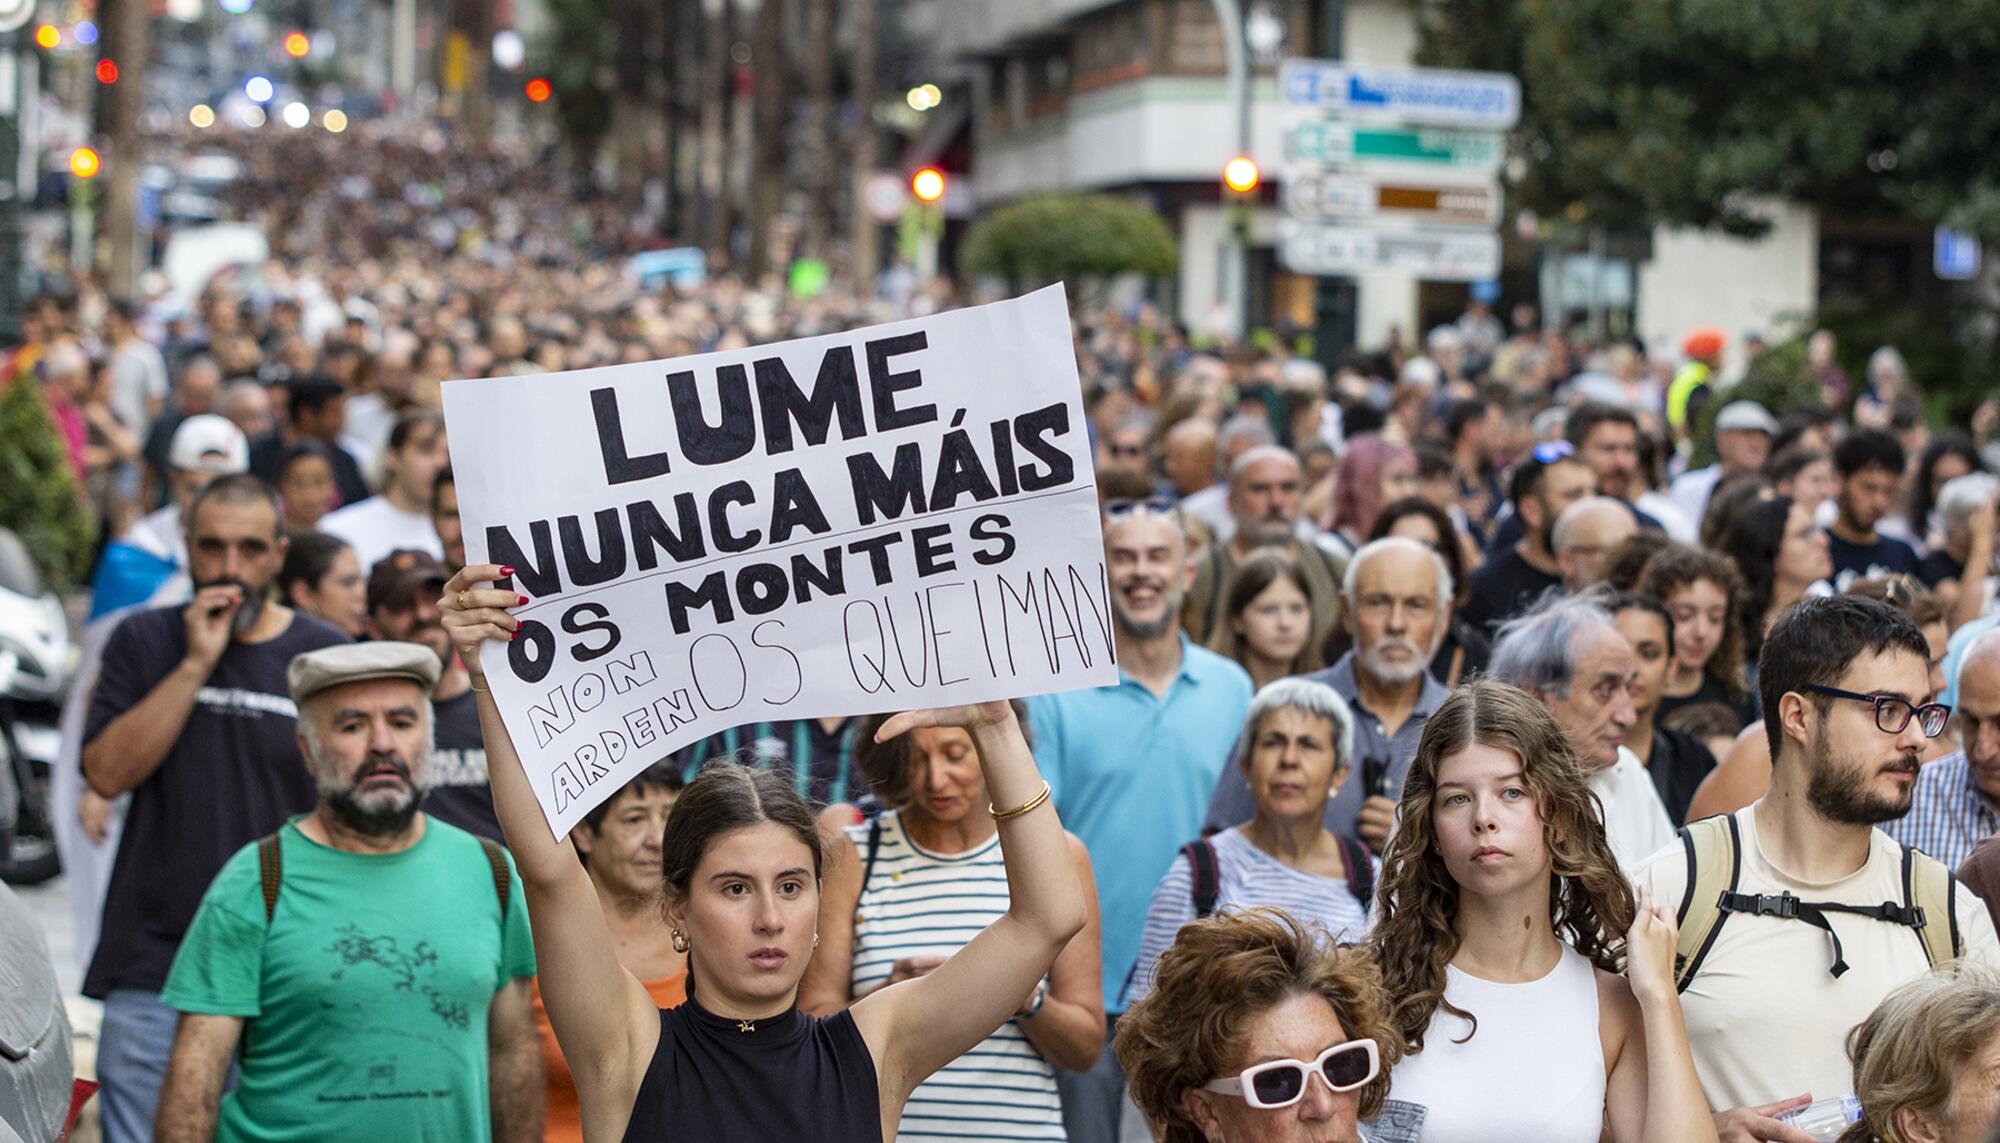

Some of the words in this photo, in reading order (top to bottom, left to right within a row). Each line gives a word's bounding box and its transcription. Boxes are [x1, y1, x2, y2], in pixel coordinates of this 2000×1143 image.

[590, 331, 937, 485] LUME
[486, 468, 831, 600] NUNCA
[846, 402, 1074, 526] MÁIS
[507, 602, 621, 683] OS
[666, 514, 1016, 634] MONTES
[689, 620, 802, 712] OS
[842, 563, 1116, 695] QUEIMAN
[527, 651, 656, 749] NON
[550, 689, 696, 815] ARDEN
